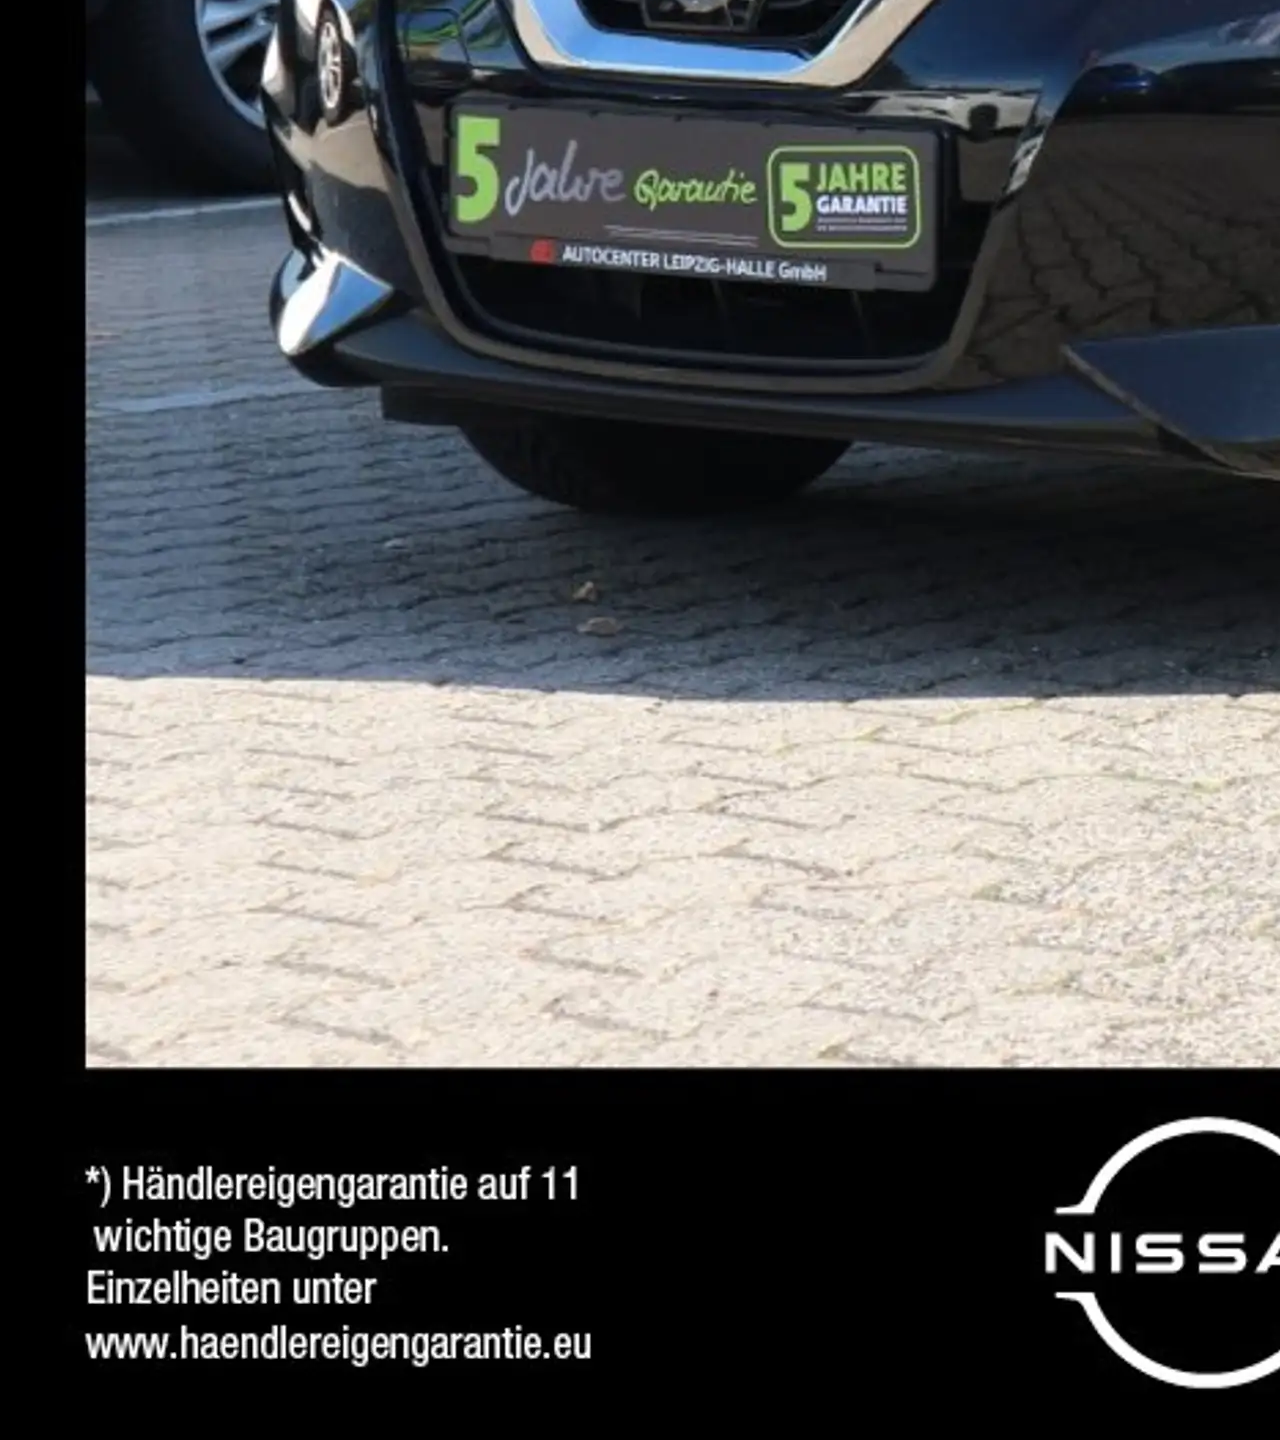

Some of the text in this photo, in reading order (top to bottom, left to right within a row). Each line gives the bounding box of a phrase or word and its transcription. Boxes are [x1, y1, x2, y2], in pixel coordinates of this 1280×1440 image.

[456, 115, 500, 223] 5
[778, 162, 907, 232] 5 JAHRE
[816, 193, 909, 216] GARANTIE
[562, 244, 828, 283] AUTOCENTER LEIPZIG-HALLE GmbH
